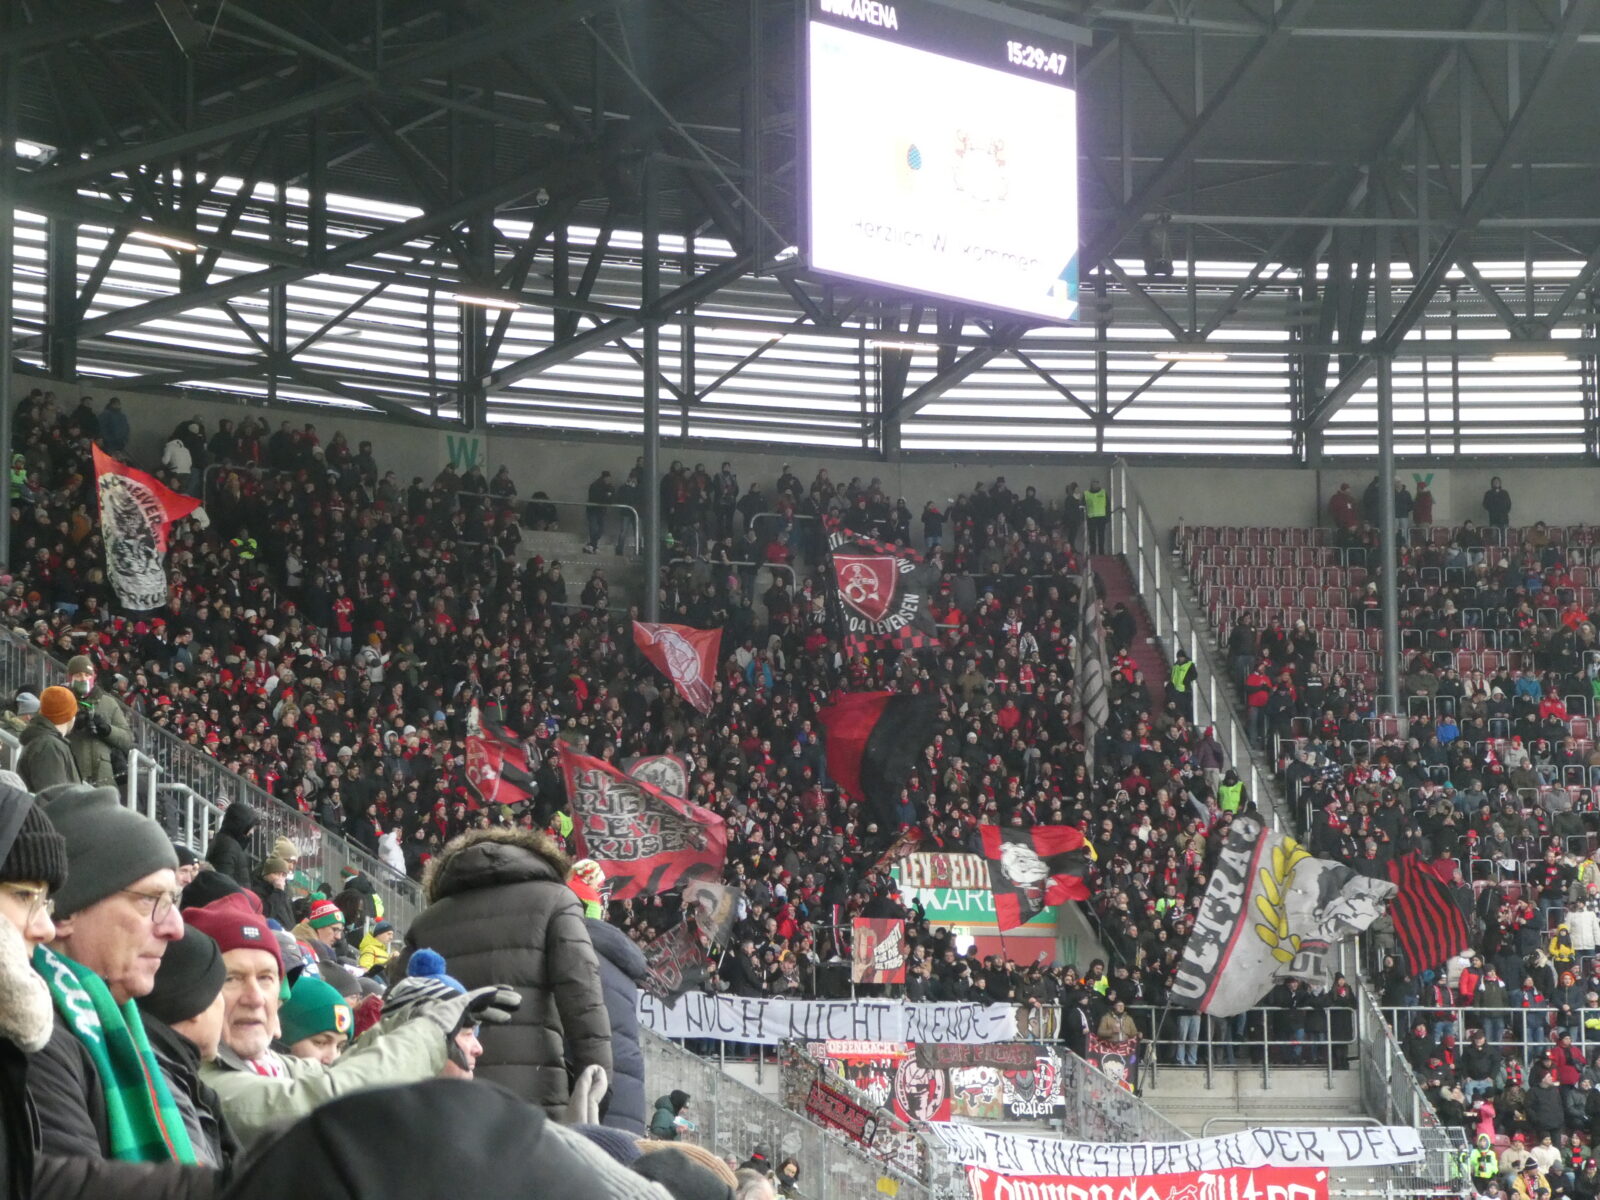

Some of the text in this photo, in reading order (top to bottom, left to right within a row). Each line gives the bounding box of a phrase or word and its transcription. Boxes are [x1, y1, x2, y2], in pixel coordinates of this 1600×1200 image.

[1007, 41, 1067, 75] 15:29:47
[901, 854, 932, 887] LEV
[685, 996, 770, 1038] NOCH
[788, 1003, 890, 1041] NICHT
[984, 1131, 1024, 1171] ZU
[1027, 1138, 1201, 1178] INVESTOREN
[1215, 1135, 1246, 1169] IN
[1252, 1128, 1325, 1163] DER
